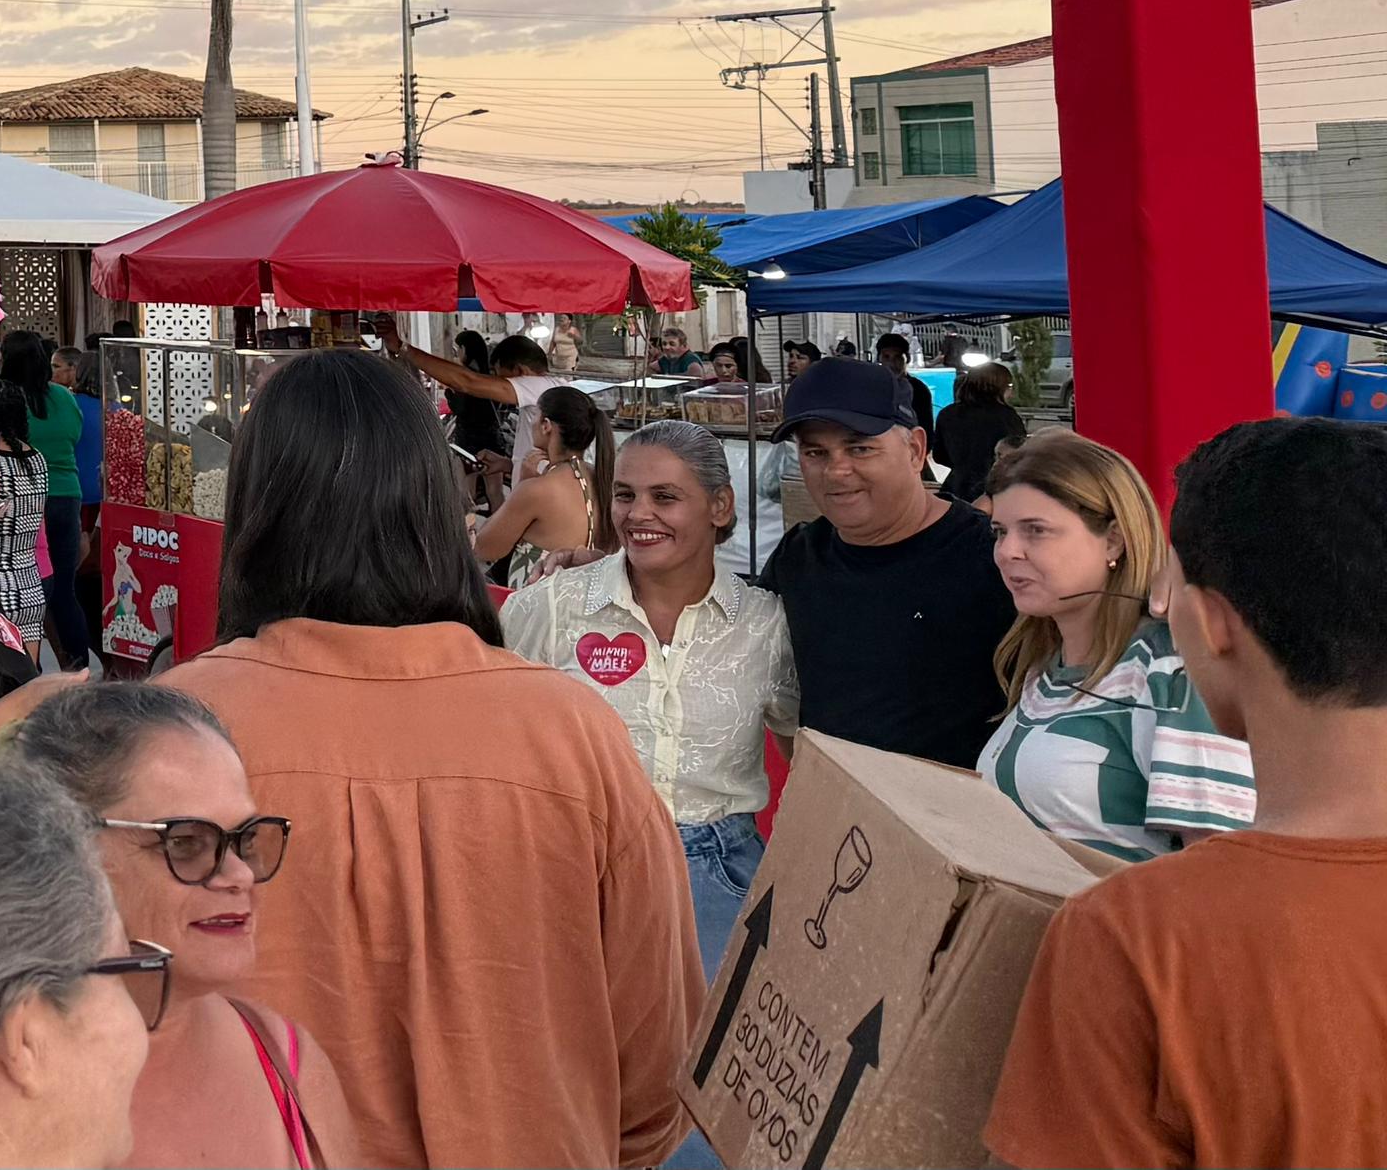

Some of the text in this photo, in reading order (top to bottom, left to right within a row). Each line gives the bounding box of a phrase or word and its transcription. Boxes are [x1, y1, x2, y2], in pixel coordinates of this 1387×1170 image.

[132, 525, 179, 550] PIPOC
[592, 647, 627, 657] MINHA
[736, 1013, 819, 1126] 30 DÚZIAS
[758, 981, 831, 1080] CONTÉM
[723, 1055, 798, 1162] DE OVOS
